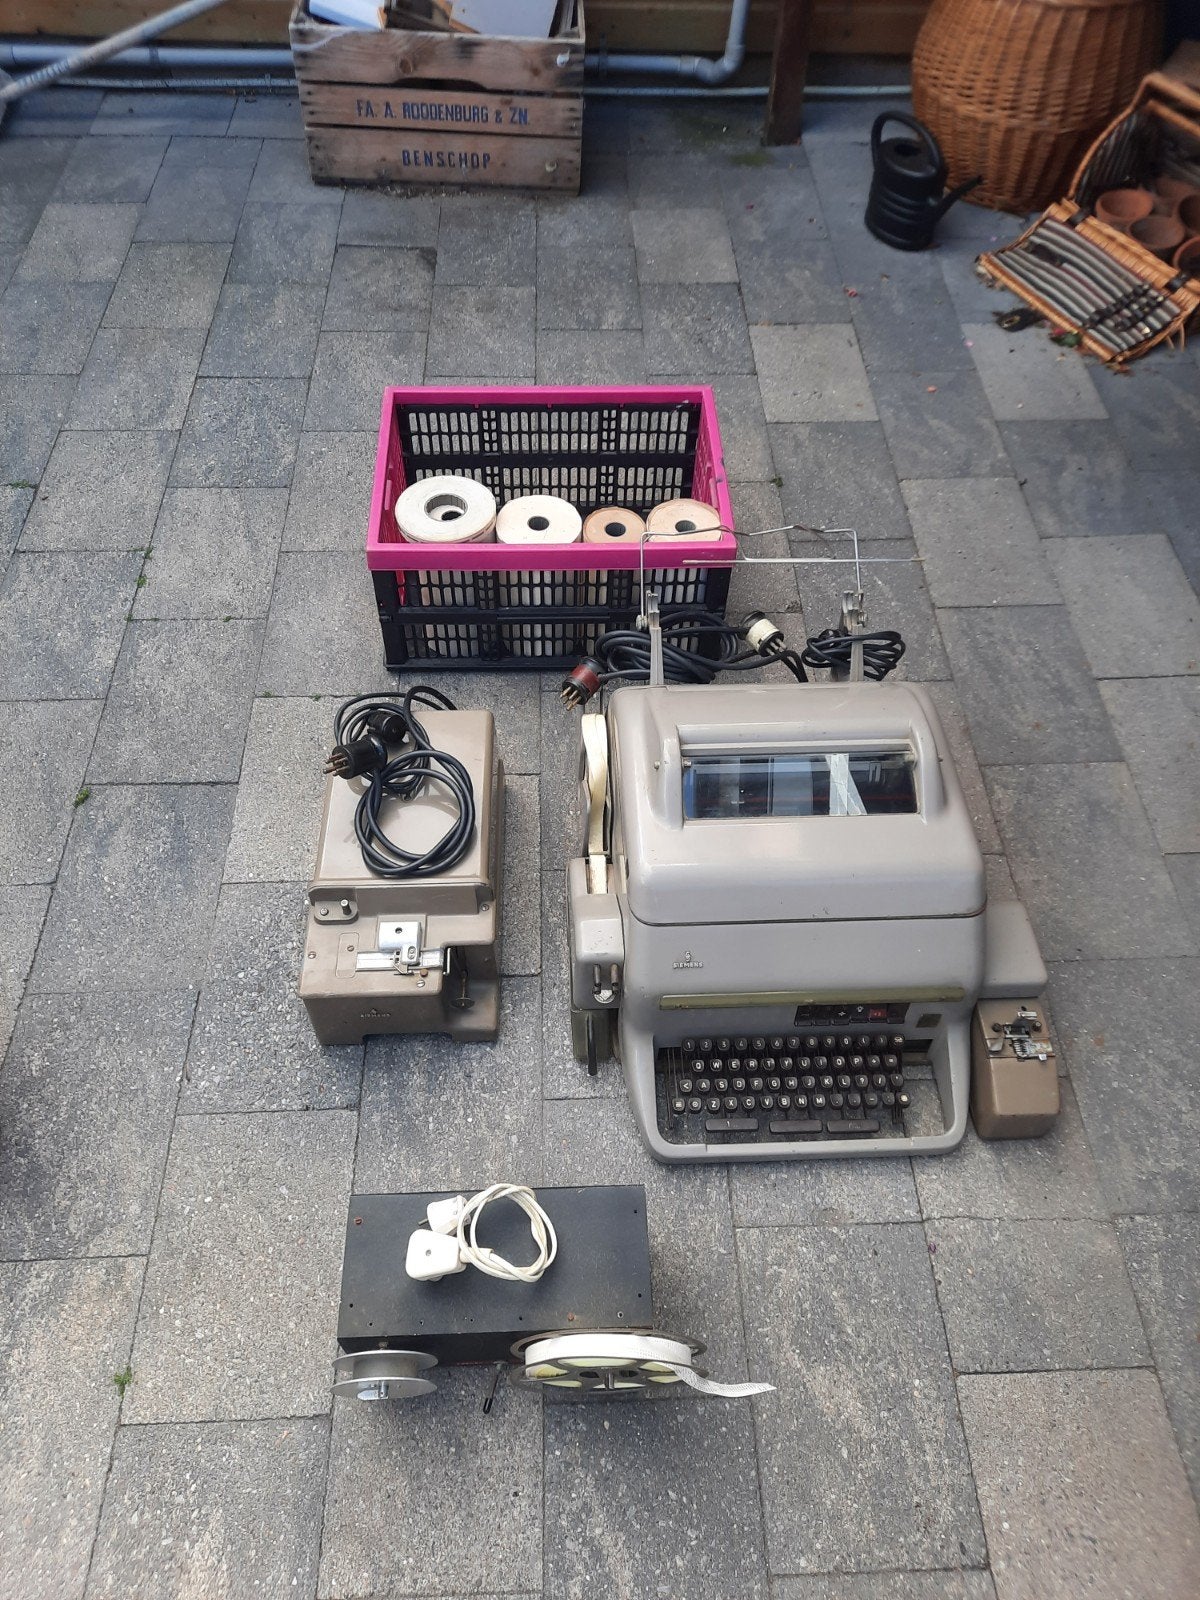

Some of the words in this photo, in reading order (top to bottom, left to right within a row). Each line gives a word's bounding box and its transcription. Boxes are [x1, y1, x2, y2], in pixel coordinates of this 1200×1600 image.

[357, 99, 377, 118] FA.
[384, 101, 396, 119] A.
[495, 110, 502, 123] &
[402, 149, 490, 168] BENSCHOP
